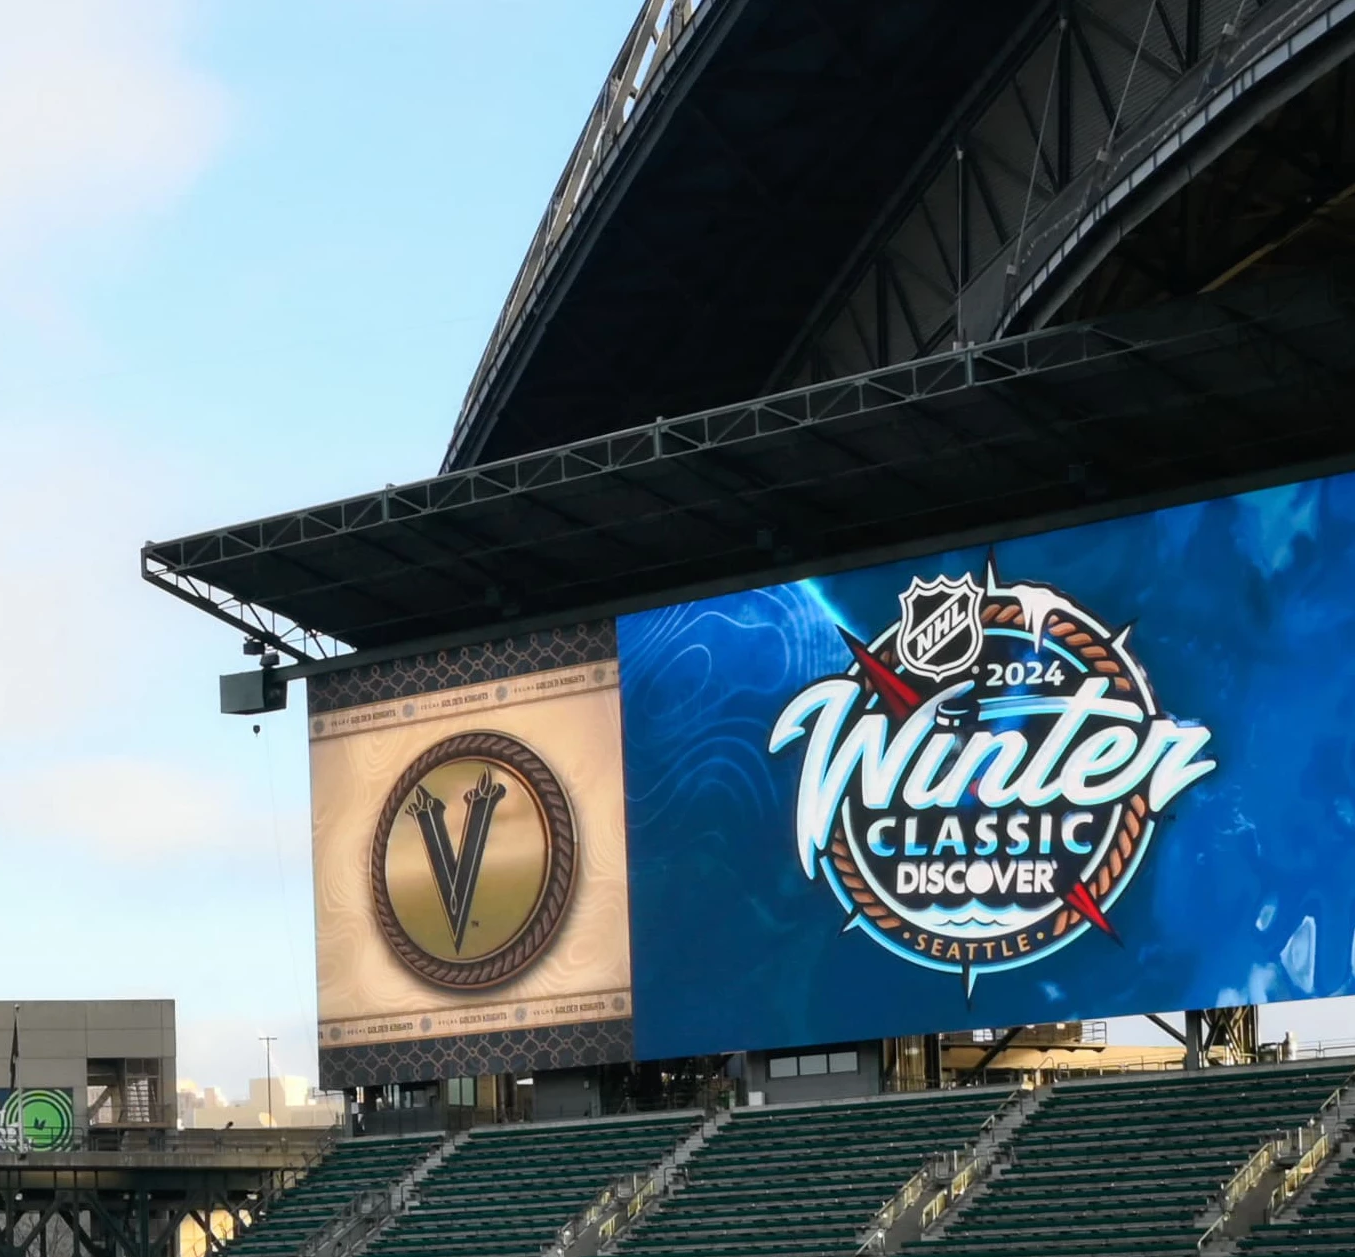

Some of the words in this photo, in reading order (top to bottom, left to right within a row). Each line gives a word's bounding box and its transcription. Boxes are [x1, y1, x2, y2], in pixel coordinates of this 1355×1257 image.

[913, 599, 966, 661] NHL
[987, 660, 1065, 687] 2024
[769, 676, 1217, 879] Winter
[867, 811, 1094, 856] CLASSIC
[896, 859, 1057, 896] DISCOVER
[915, 933, 1031, 961] SEATTLE
